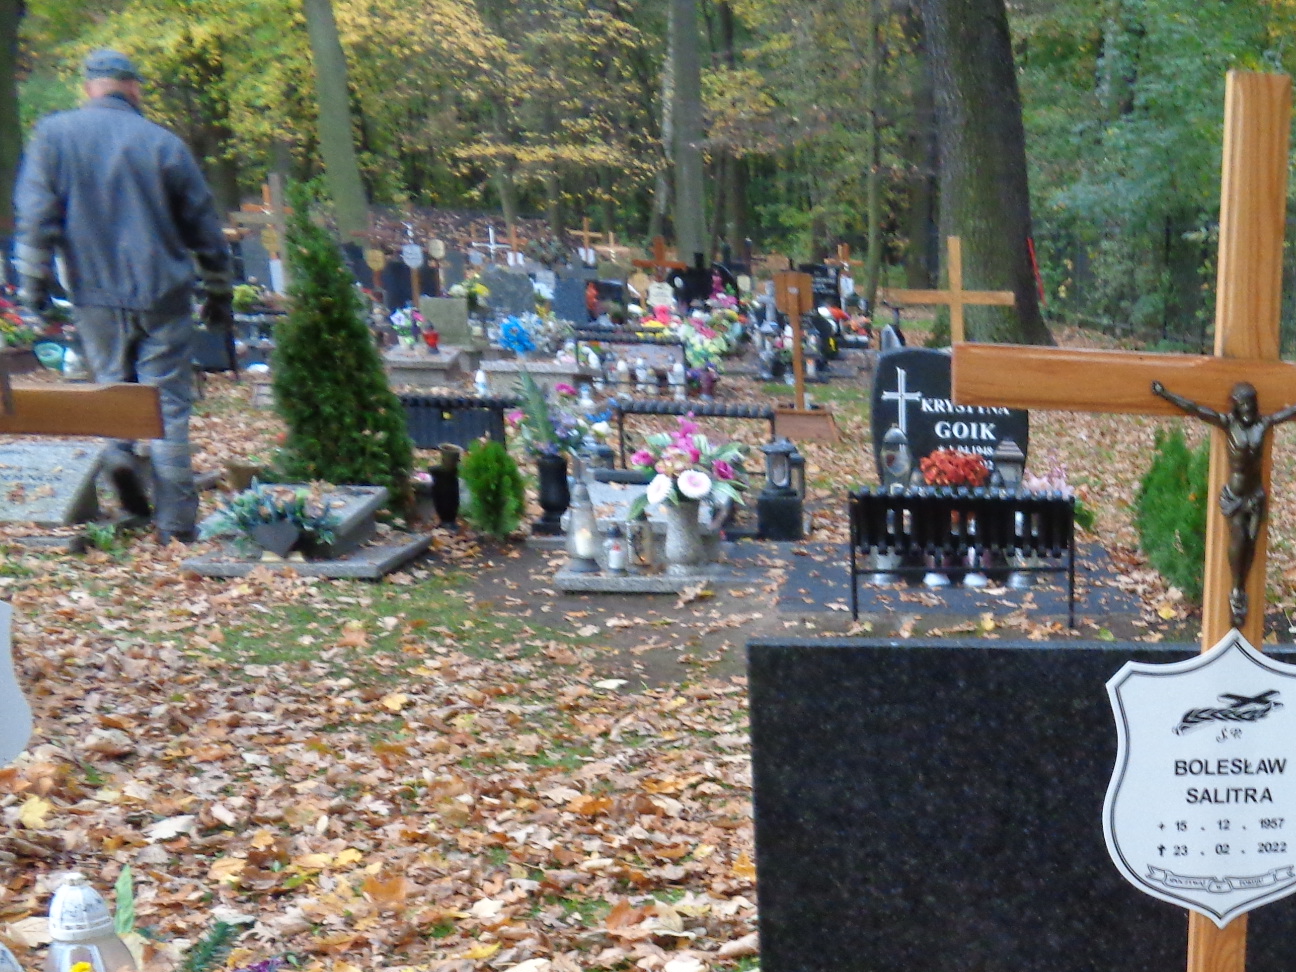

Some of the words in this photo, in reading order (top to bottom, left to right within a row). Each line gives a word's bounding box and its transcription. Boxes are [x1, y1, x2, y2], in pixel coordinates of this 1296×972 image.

[934, 420, 996, 440] GOIK
[1174, 758, 1287, 776] BOLESŁAW
[1186, 787, 1273, 804] SALITRA
[1258, 841, 1287, 854] 2022
